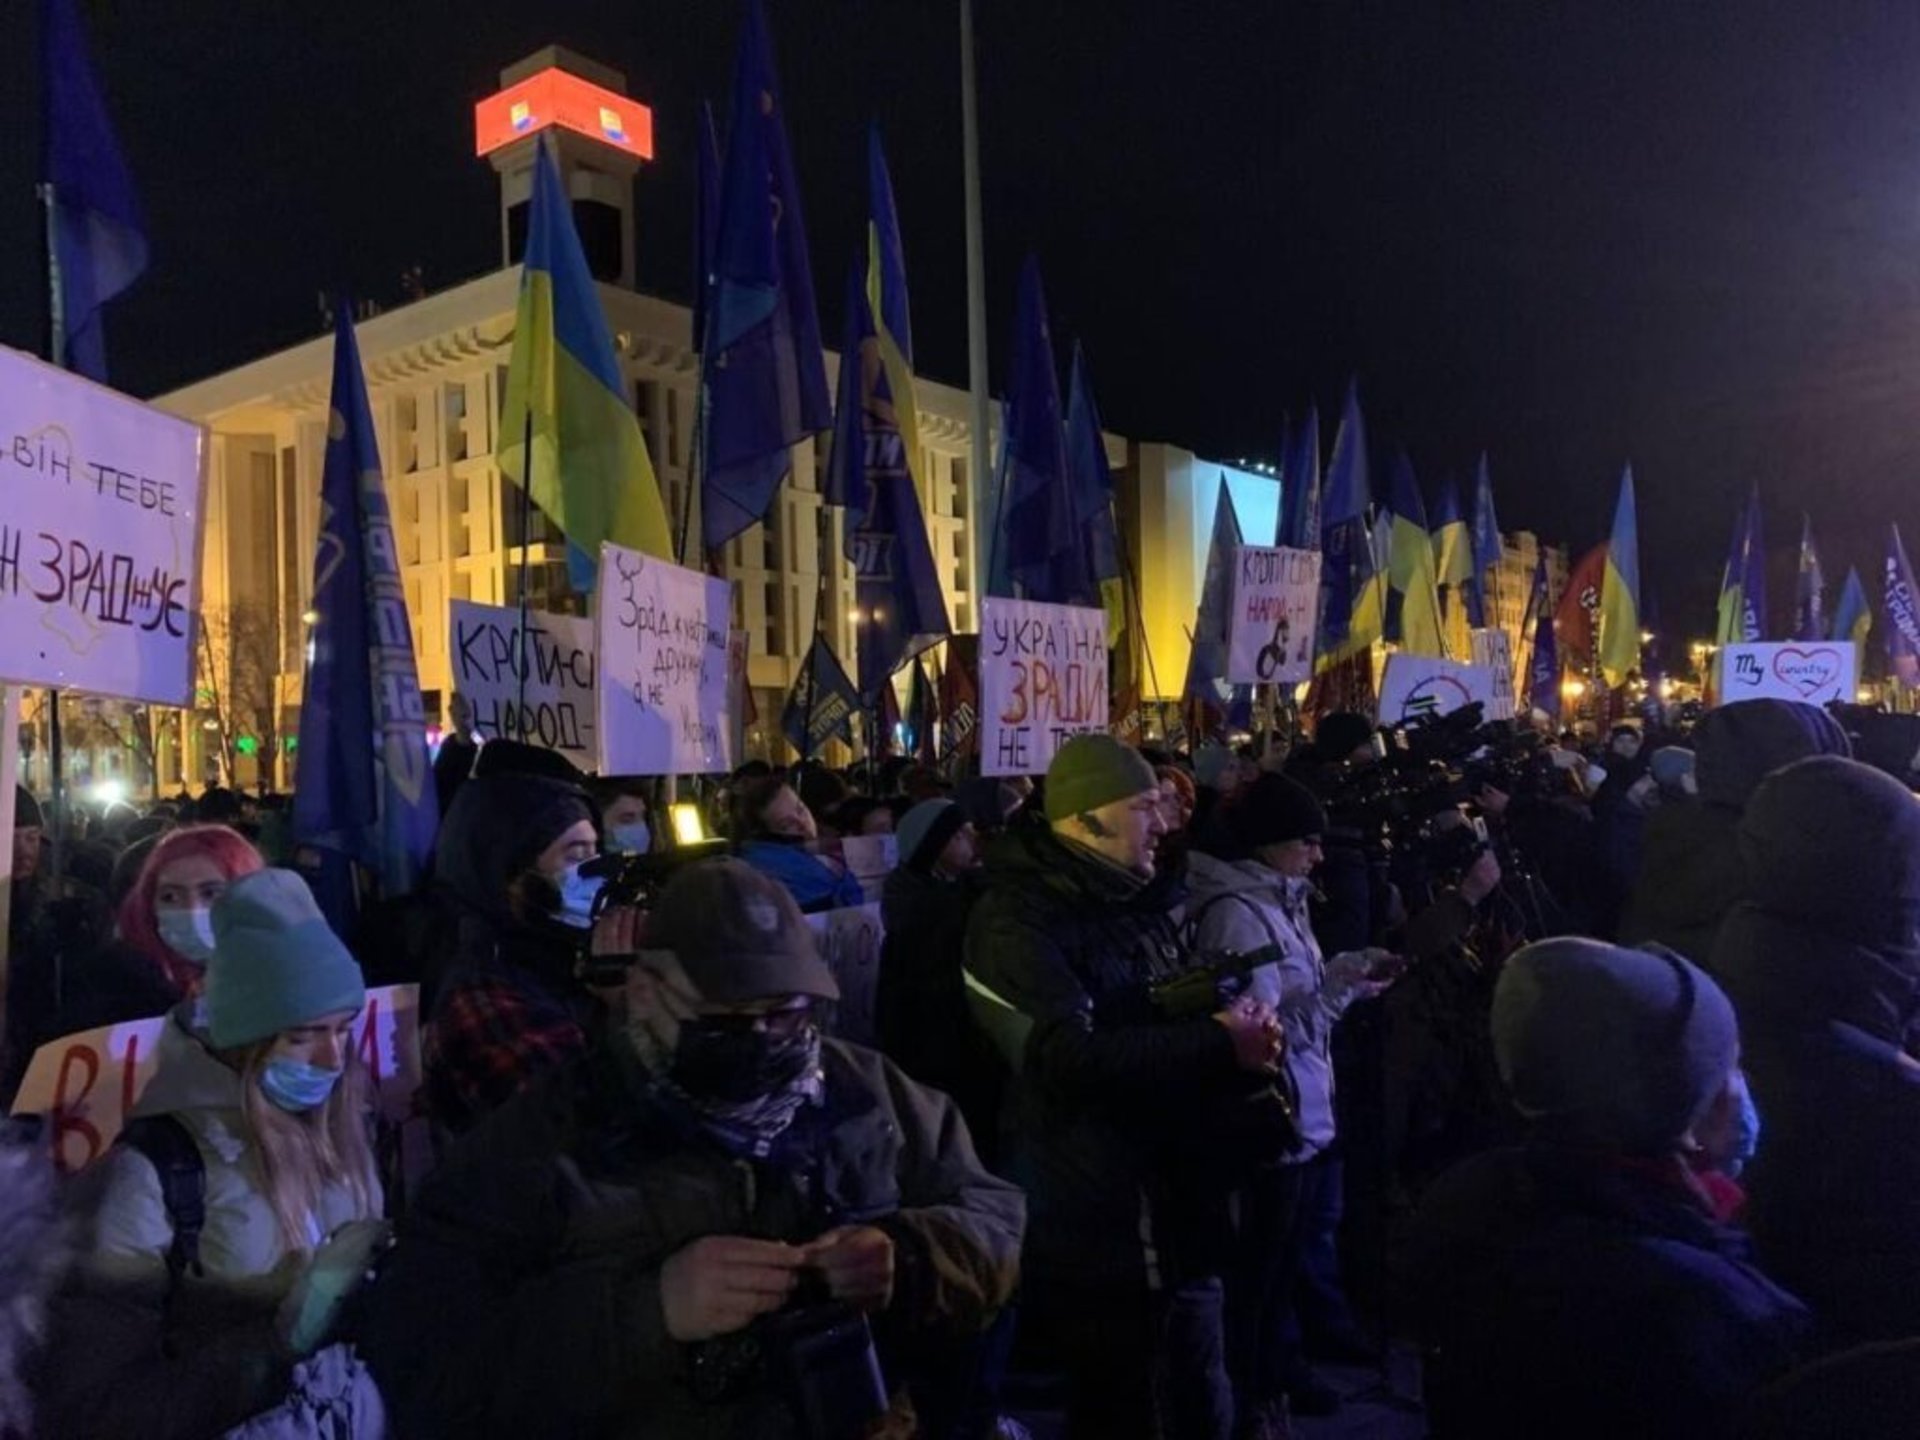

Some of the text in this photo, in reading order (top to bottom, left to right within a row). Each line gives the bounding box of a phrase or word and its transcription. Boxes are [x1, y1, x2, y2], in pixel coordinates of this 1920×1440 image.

[88, 461, 175, 517] ТЕБЕ
[993, 617, 1104, 661] УКРАЇНА
[1735, 653, 1764, 686] My
[1001, 660, 1104, 724] ЗРАДИ
[998, 726, 1031, 769] НЕ
